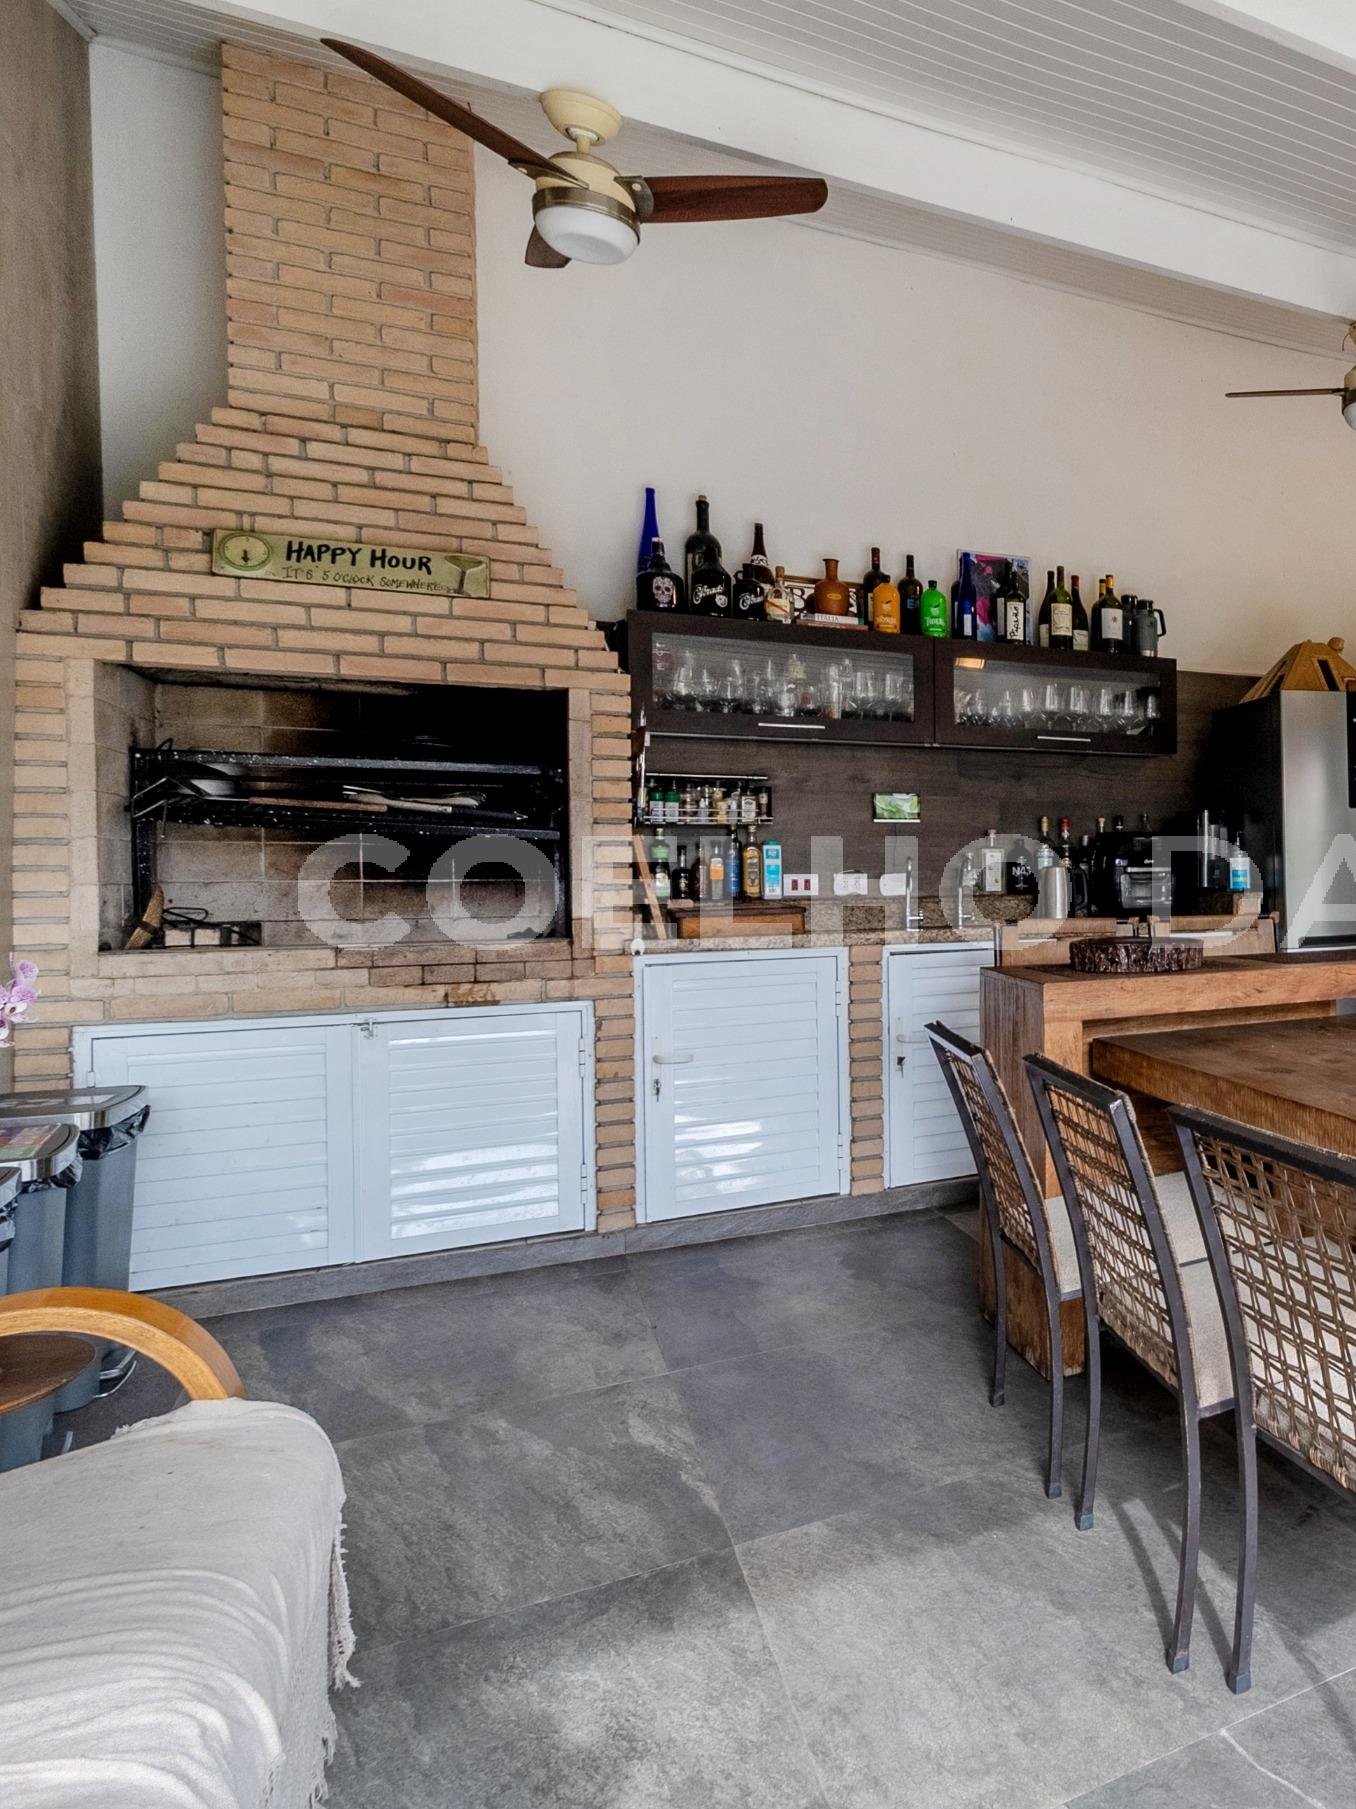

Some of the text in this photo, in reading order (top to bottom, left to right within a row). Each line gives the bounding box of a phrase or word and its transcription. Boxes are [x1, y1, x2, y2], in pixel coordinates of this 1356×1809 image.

[286, 540, 432, 575] HAPPY HOUR
[322, 570, 330, 581] 5
